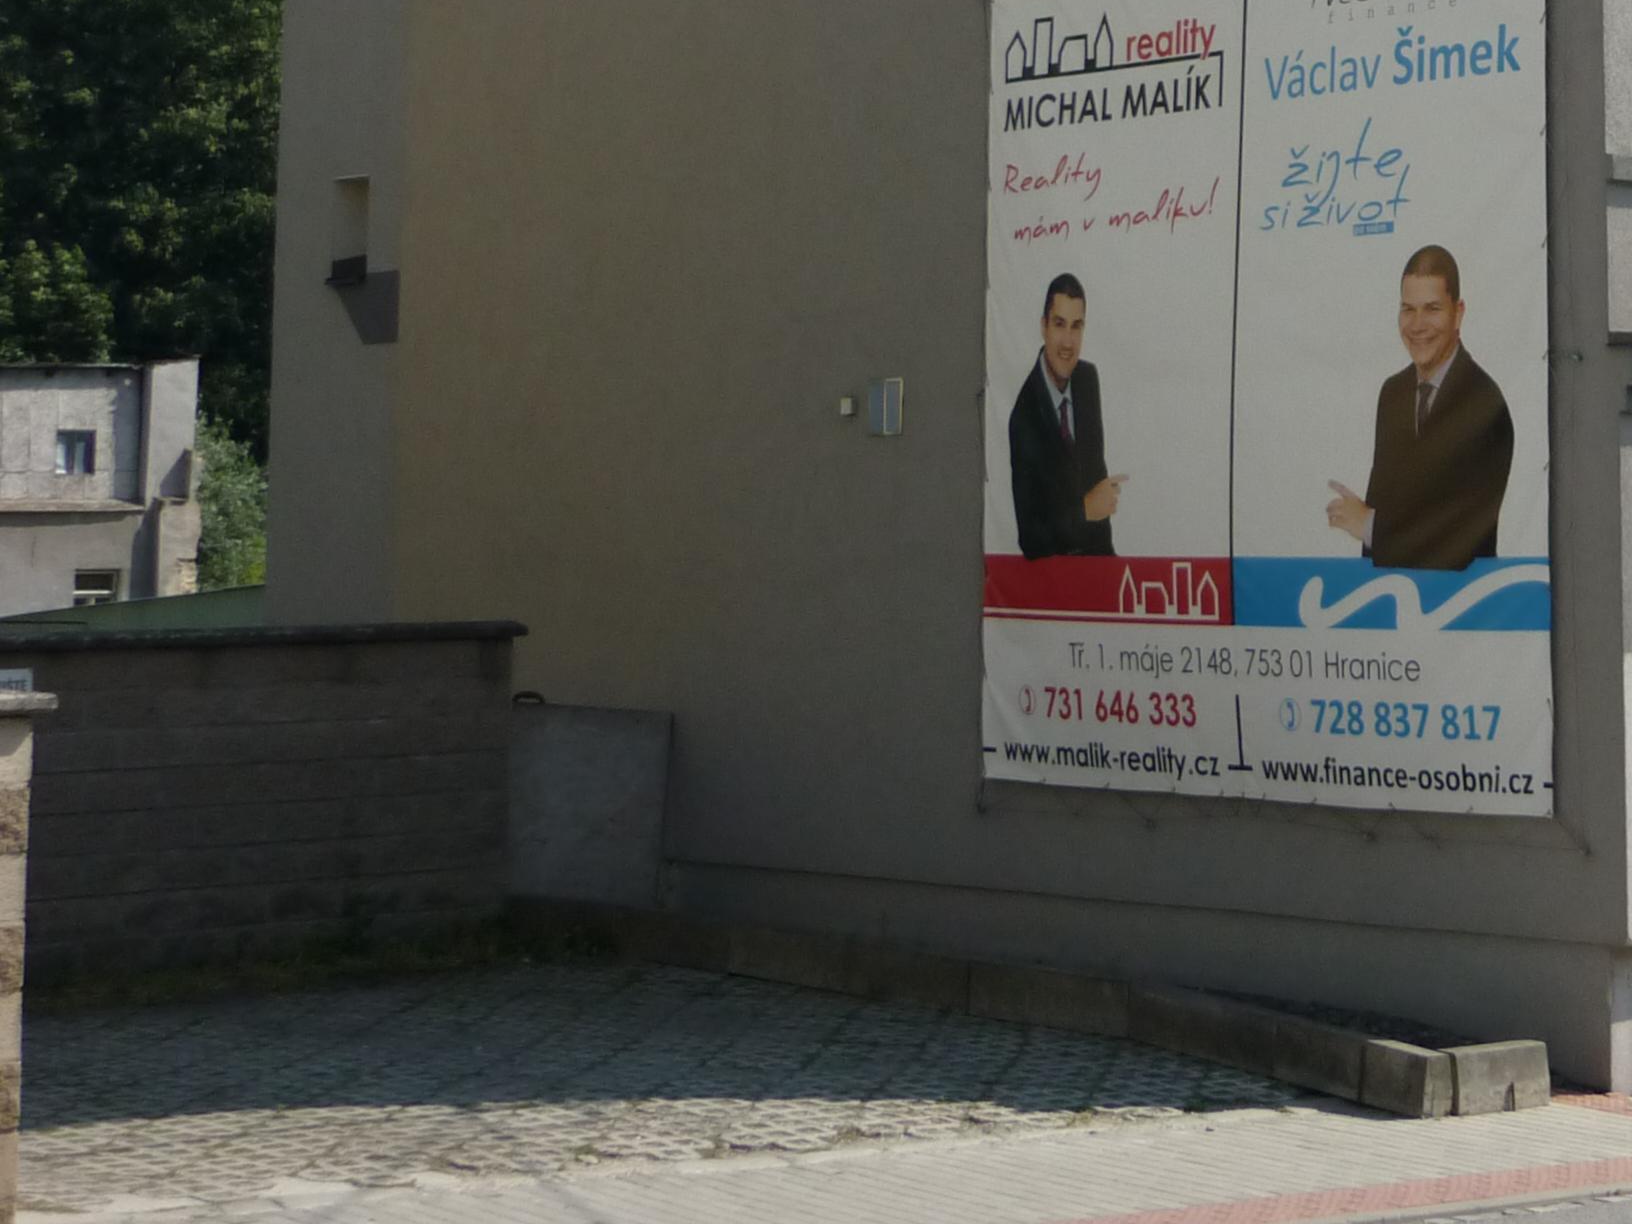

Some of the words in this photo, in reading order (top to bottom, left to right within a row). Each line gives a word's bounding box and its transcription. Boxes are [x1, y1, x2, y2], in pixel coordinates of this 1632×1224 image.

[1126, 18, 1216, 62] reality
[1264, 45, 1382, 100] Václav
[1392, 24, 1521, 85] Šimek
[1003, 88, 1113, 132] MICHAL
[1121, 65, 1212, 119] MALÍK
[1003, 152, 1102, 202] Reality
[1260, 201, 1291, 230] si
[1296, 164, 1411, 227] život
[1014, 216, 1070, 246] mám
[1083, 218, 1095, 232] v
[1069, 642, 1090, 670] Tř.
[1098, 644, 1113, 670] 1.
[1120, 644, 1173, 678] máje
[1181, 646, 1238, 677] 2148,
[1245, 648, 1283, 677] 753
[1289, 649, 1312, 677] 01
[1325, 652, 1420, 681] Hranice
[1044, 687, 1083, 720] 731
[1096, 690, 1139, 724] 646
[1149, 692, 1197, 728] 333
[1310, 699, 1365, 736] 728
[1374, 701, 1429, 738] 837
[1441, 705, 1501, 740] 817
[1004, 741, 1221, 780] www.malik-reality.cz
[1262, 756, 1534, 795] www.finance-osobni.cz
